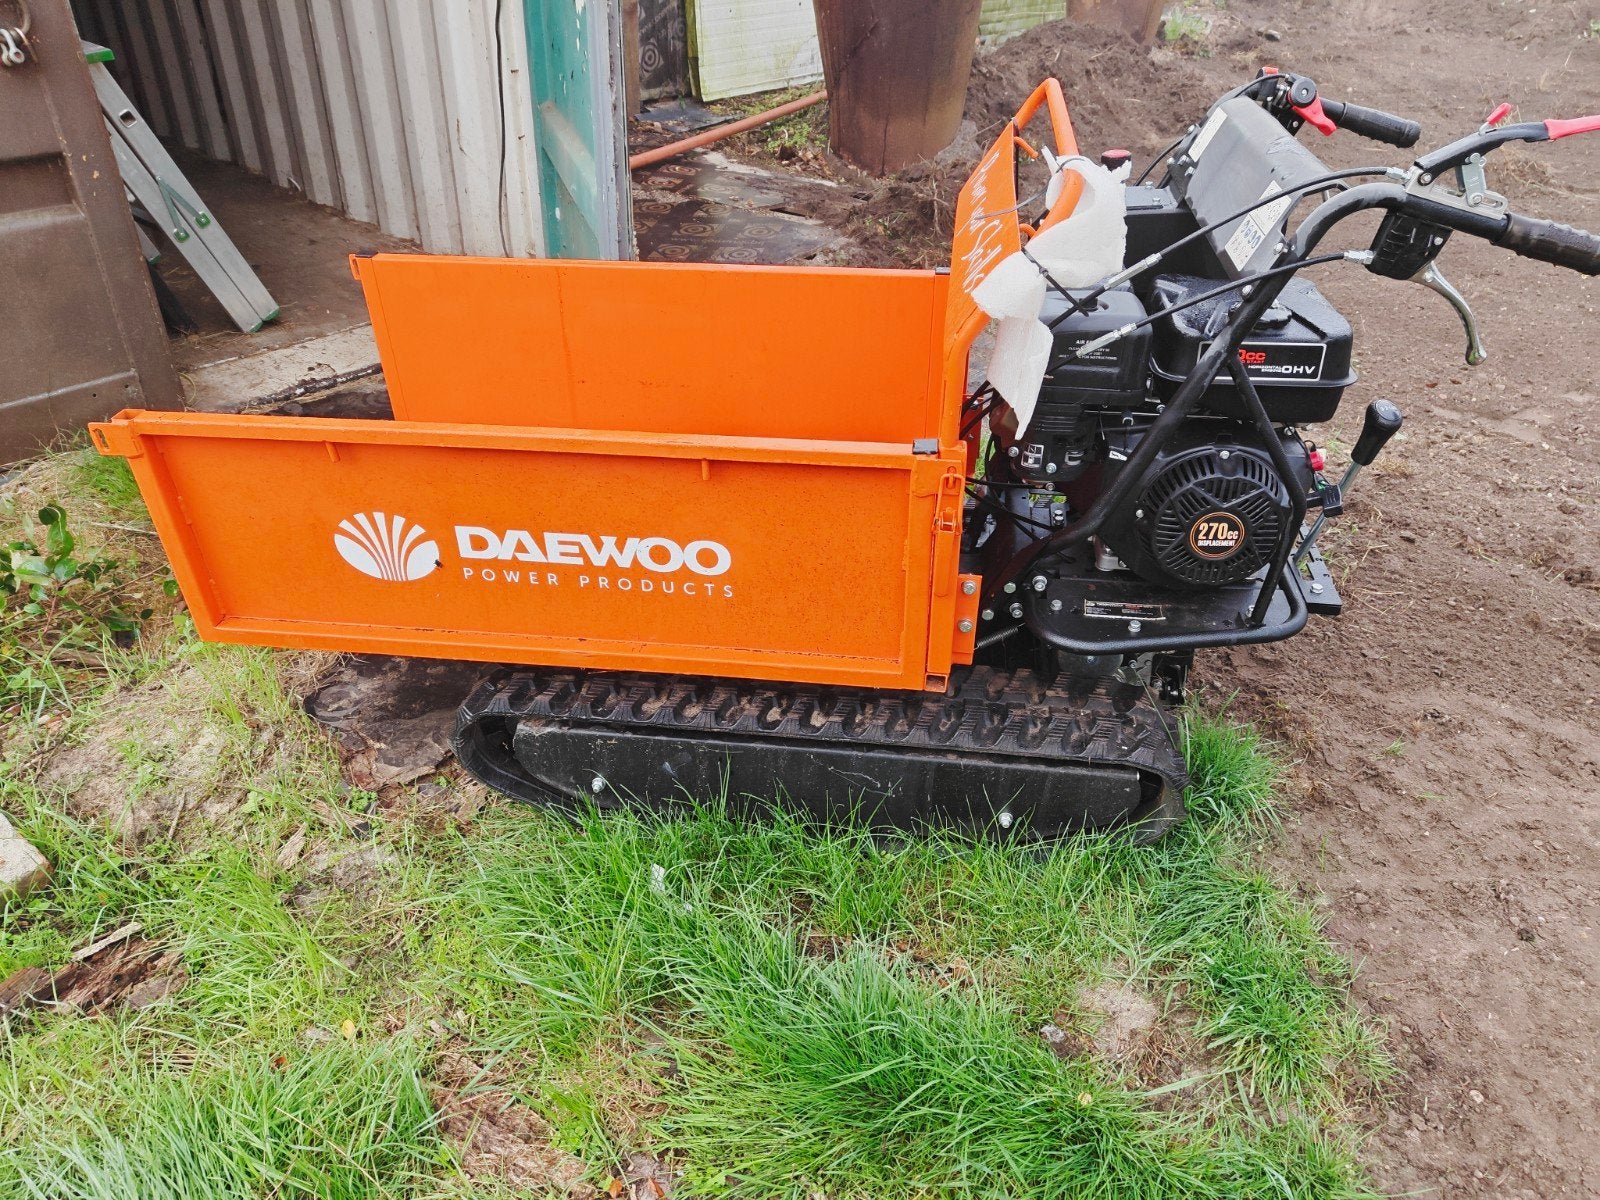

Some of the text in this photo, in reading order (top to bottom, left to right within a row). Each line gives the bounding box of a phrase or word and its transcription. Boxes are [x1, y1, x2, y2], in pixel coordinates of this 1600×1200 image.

[1282, 365, 1316, 374] OHV
[1198, 522, 1239, 540] 270cc
[454, 525, 731, 576] DAEWOO
[463, 567, 733, 598] POWER PRODUCTS
